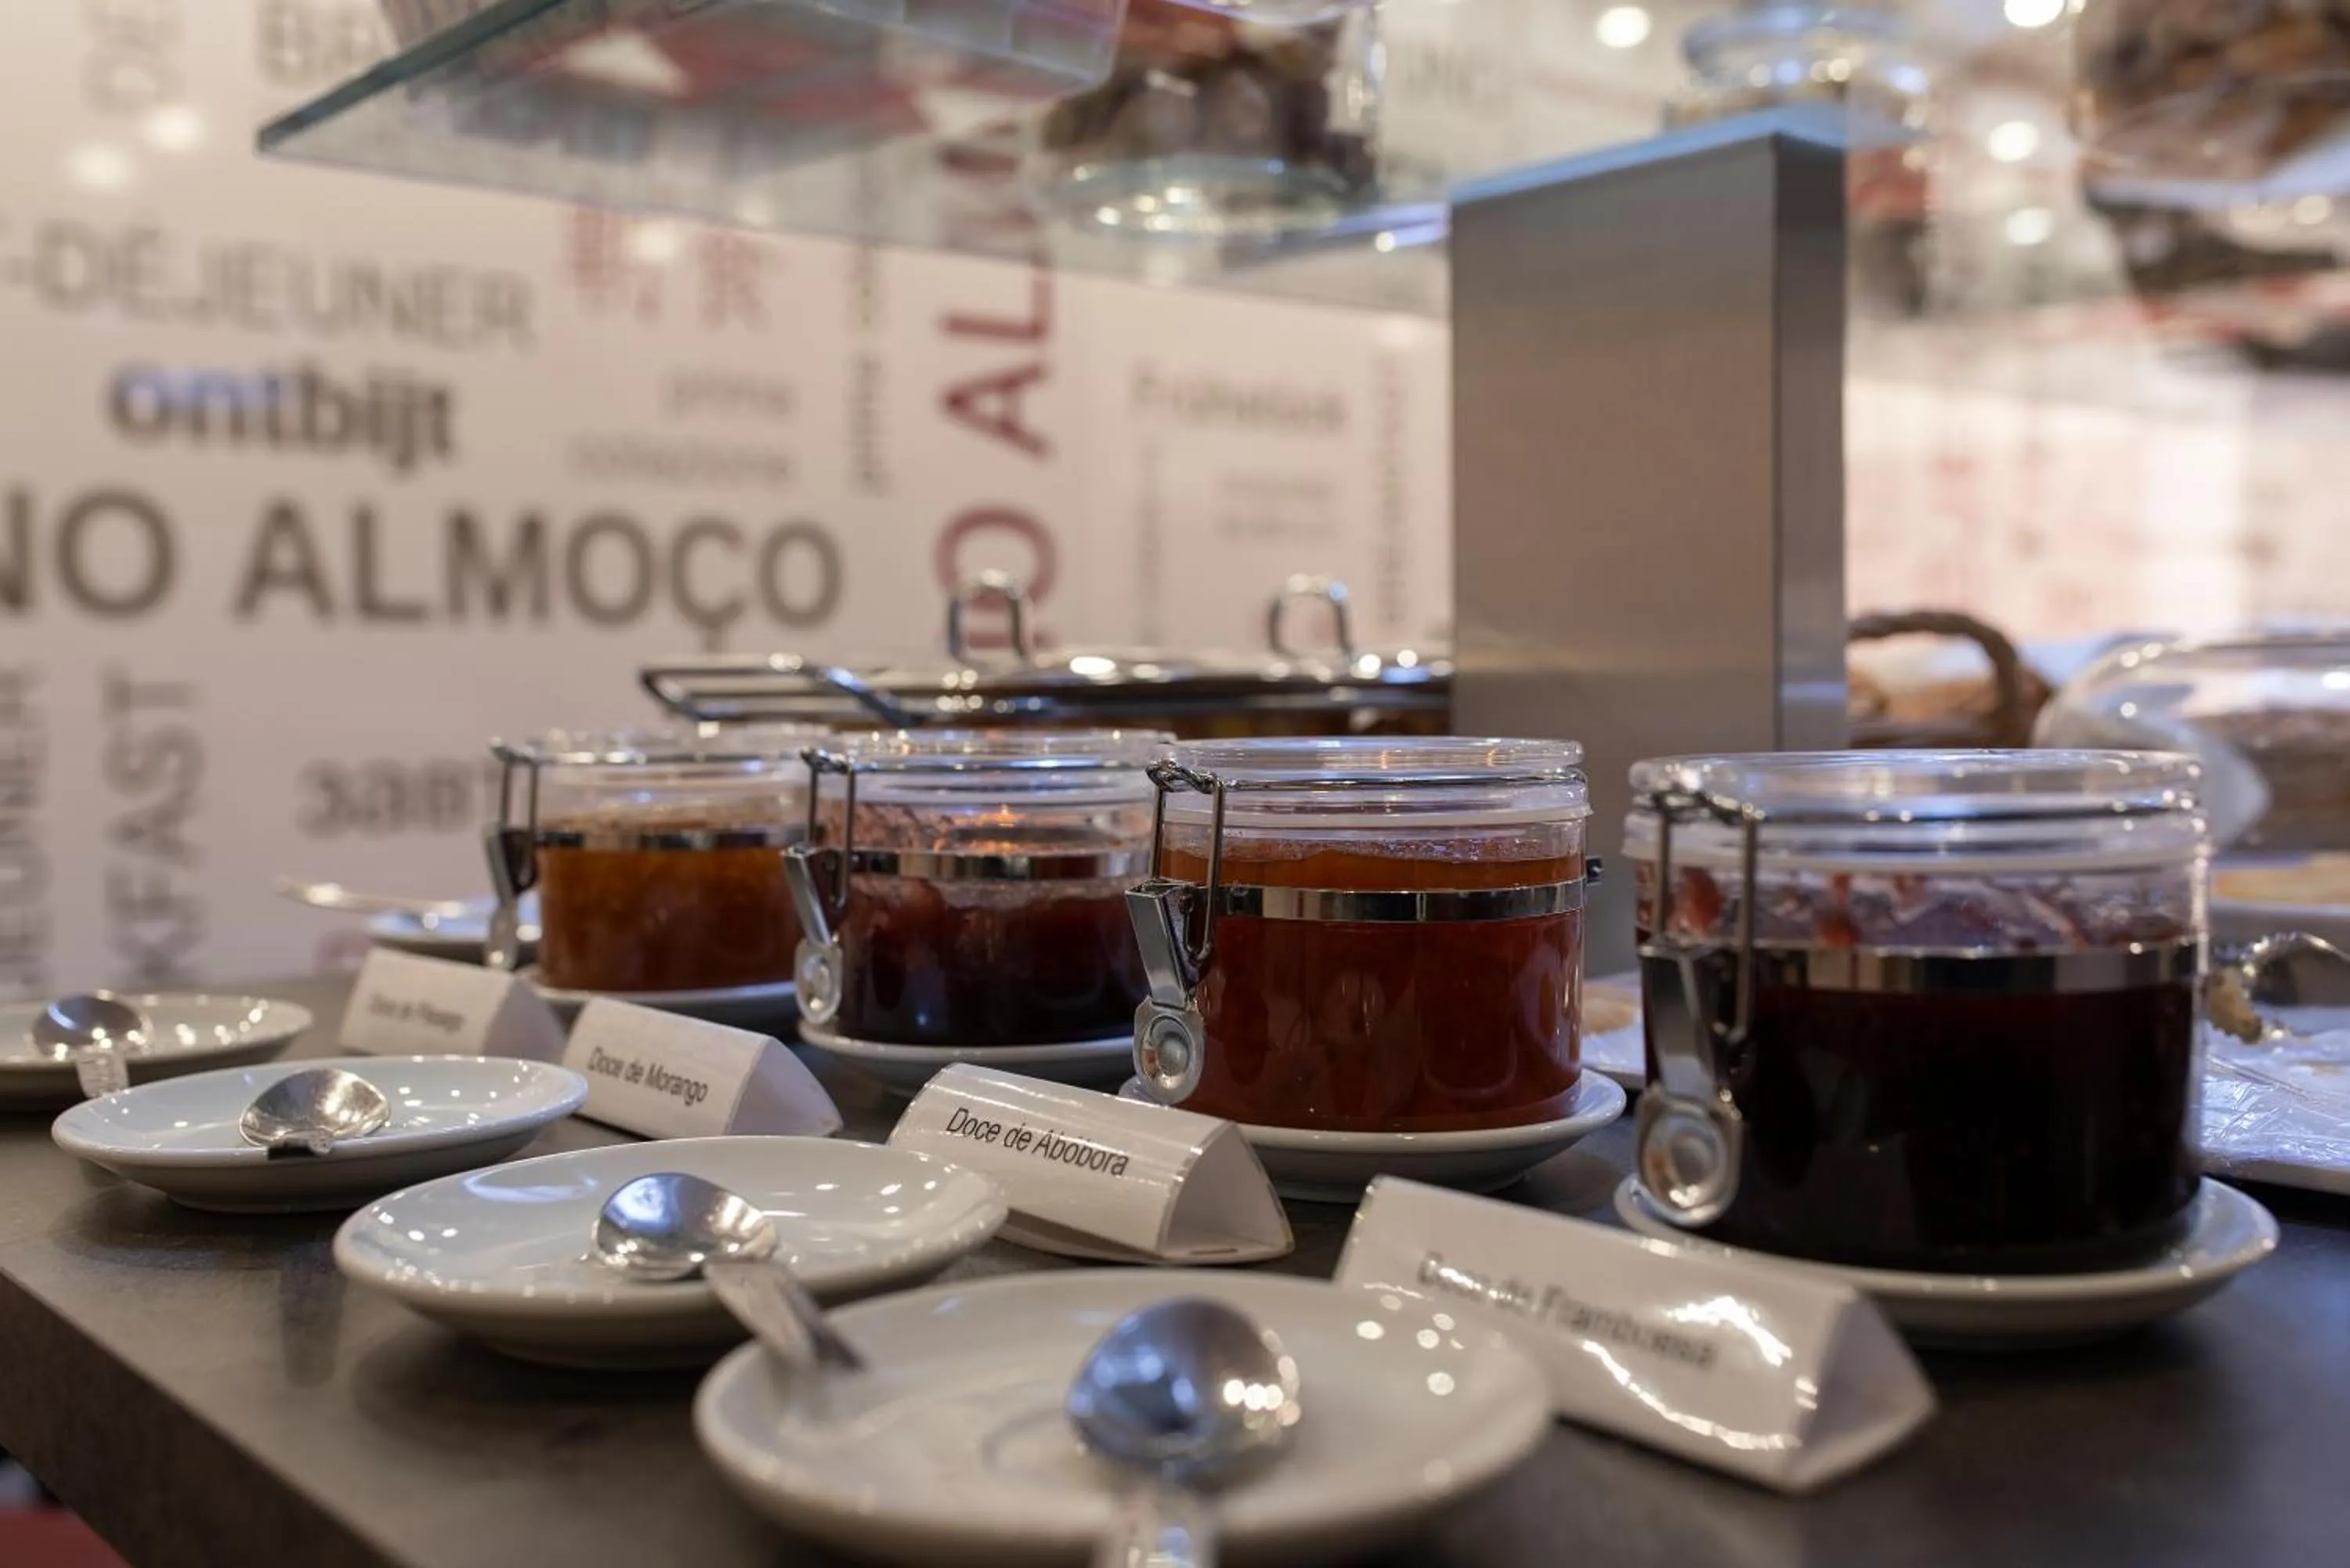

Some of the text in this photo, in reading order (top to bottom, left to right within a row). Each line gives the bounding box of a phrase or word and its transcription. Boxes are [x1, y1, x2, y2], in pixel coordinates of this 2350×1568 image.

[110, 362, 454, 476] ontbijt
[235, 497, 842, 655] ALMOÇO
[588, 1046, 708, 1106] Doce de Morango
[946, 1107, 1001, 1143] Doce
[1003, 1123, 1032, 1151] de
